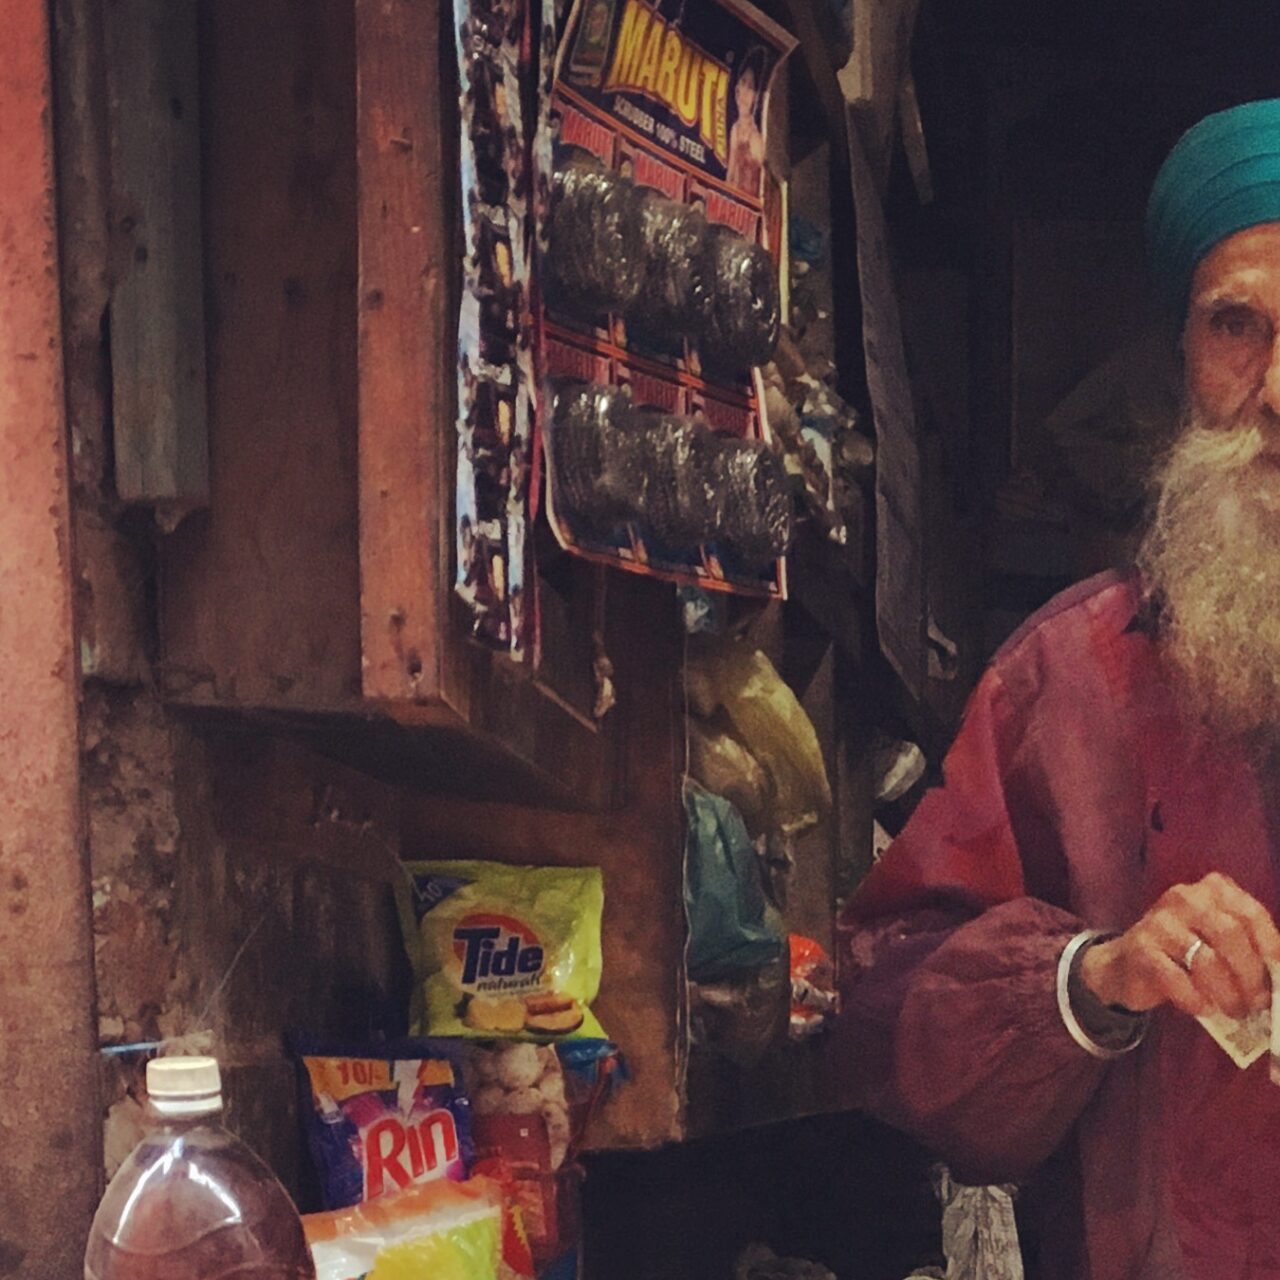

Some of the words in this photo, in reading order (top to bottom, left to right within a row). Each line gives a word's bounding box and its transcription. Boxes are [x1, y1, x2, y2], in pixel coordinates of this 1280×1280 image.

[606, 0, 731, 165] MARUTI
[679, 135, 706, 164] STEEL
[453, 927, 544, 984] Tide
[365, 1111, 458, 1202] Rin
